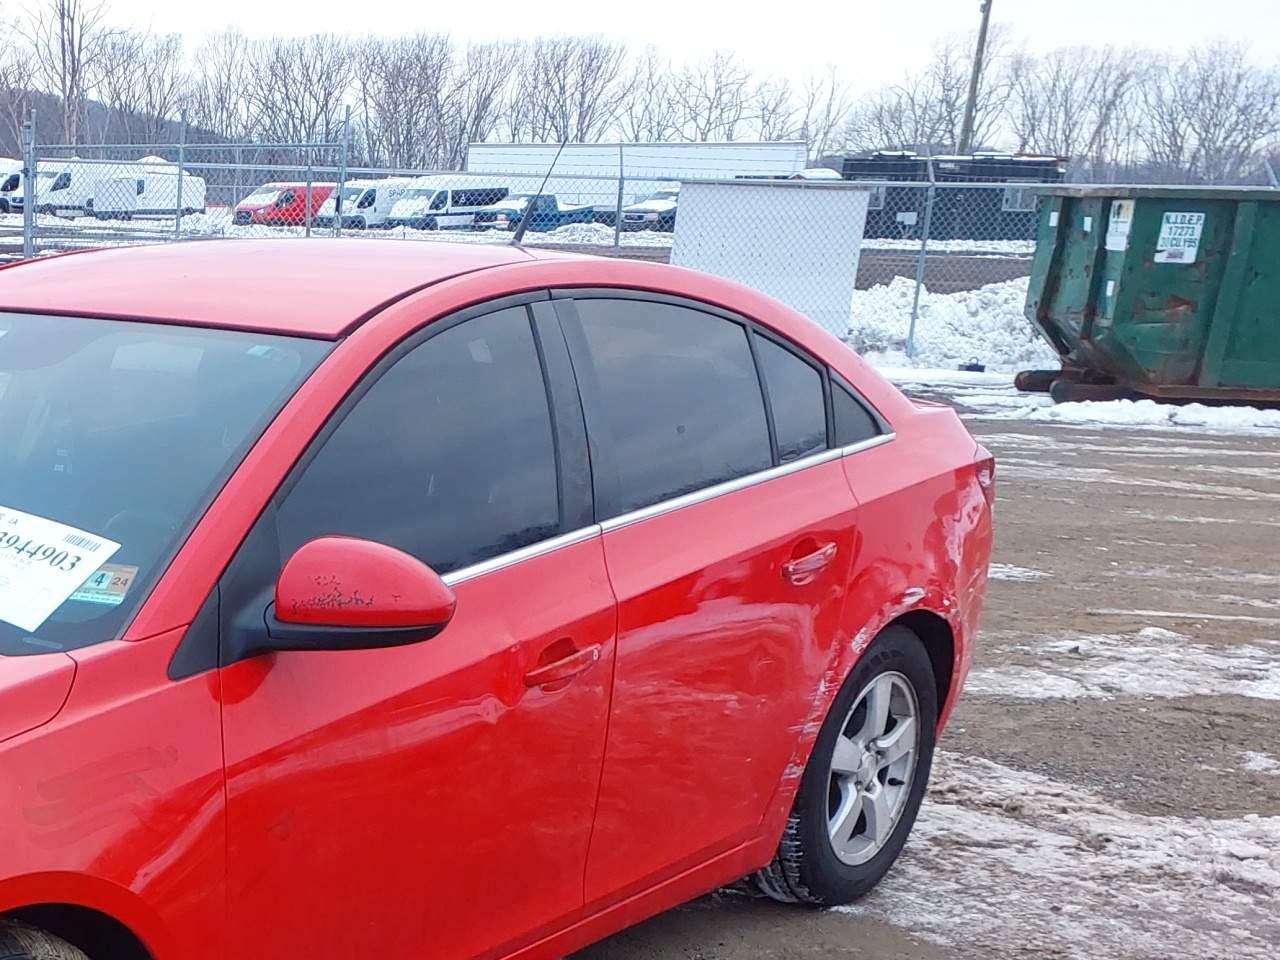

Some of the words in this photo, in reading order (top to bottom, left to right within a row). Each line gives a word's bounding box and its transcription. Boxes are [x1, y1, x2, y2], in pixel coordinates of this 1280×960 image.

[1168, 226, 1194, 236] 17273
[94, 572, 107, 588] 4
[111, 576, 129, 588] 24
